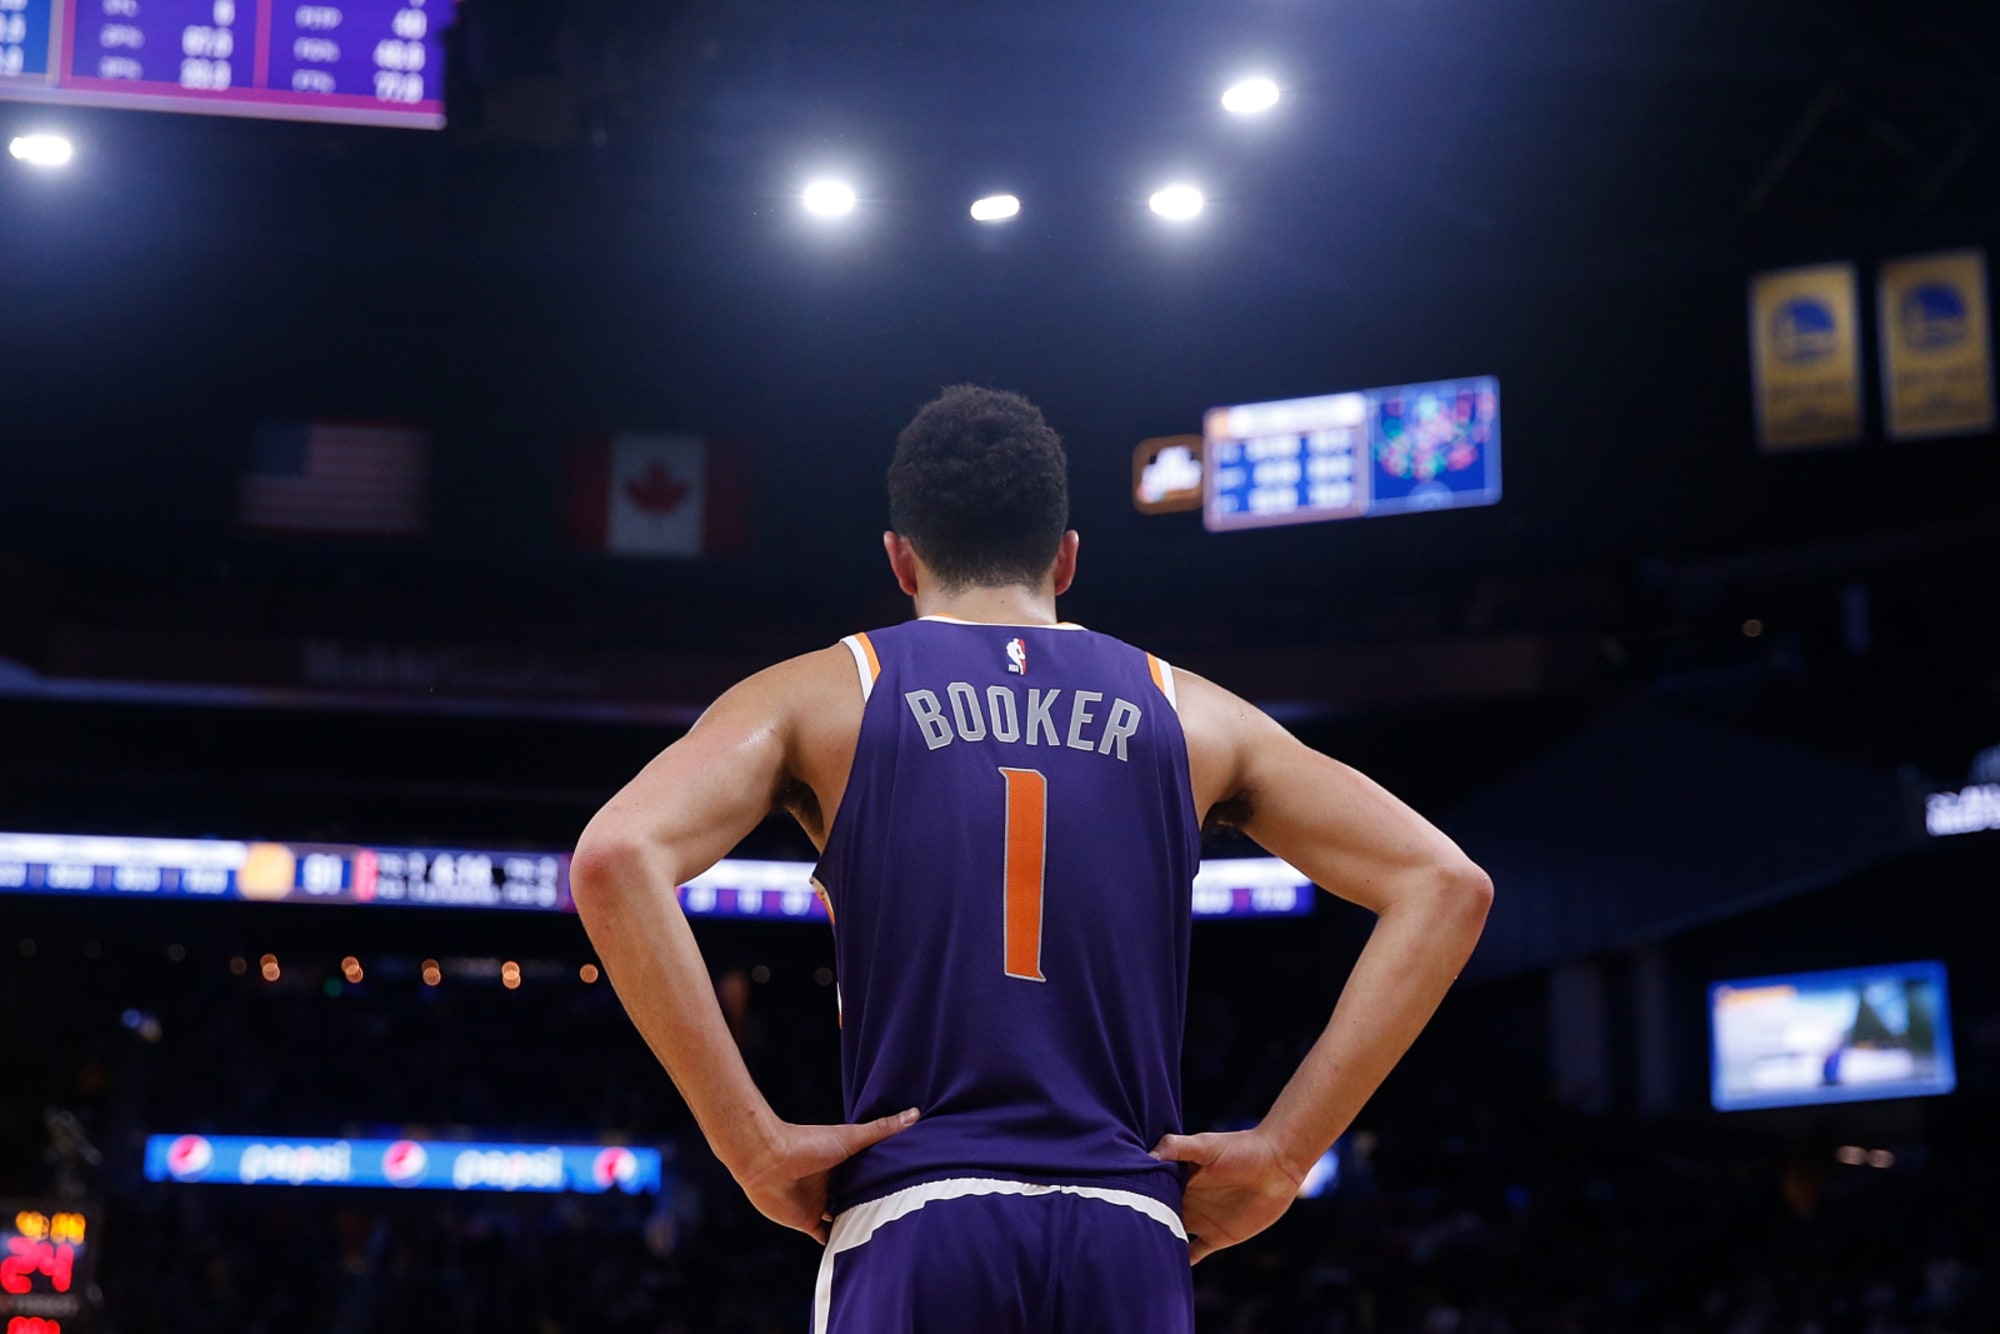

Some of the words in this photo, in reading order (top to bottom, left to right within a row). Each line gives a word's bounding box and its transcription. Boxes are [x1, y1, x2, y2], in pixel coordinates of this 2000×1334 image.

[905, 682, 1142, 762] BOOKER
[998, 766, 1047, 983] 1
[0, 1236, 74, 1294] 24
